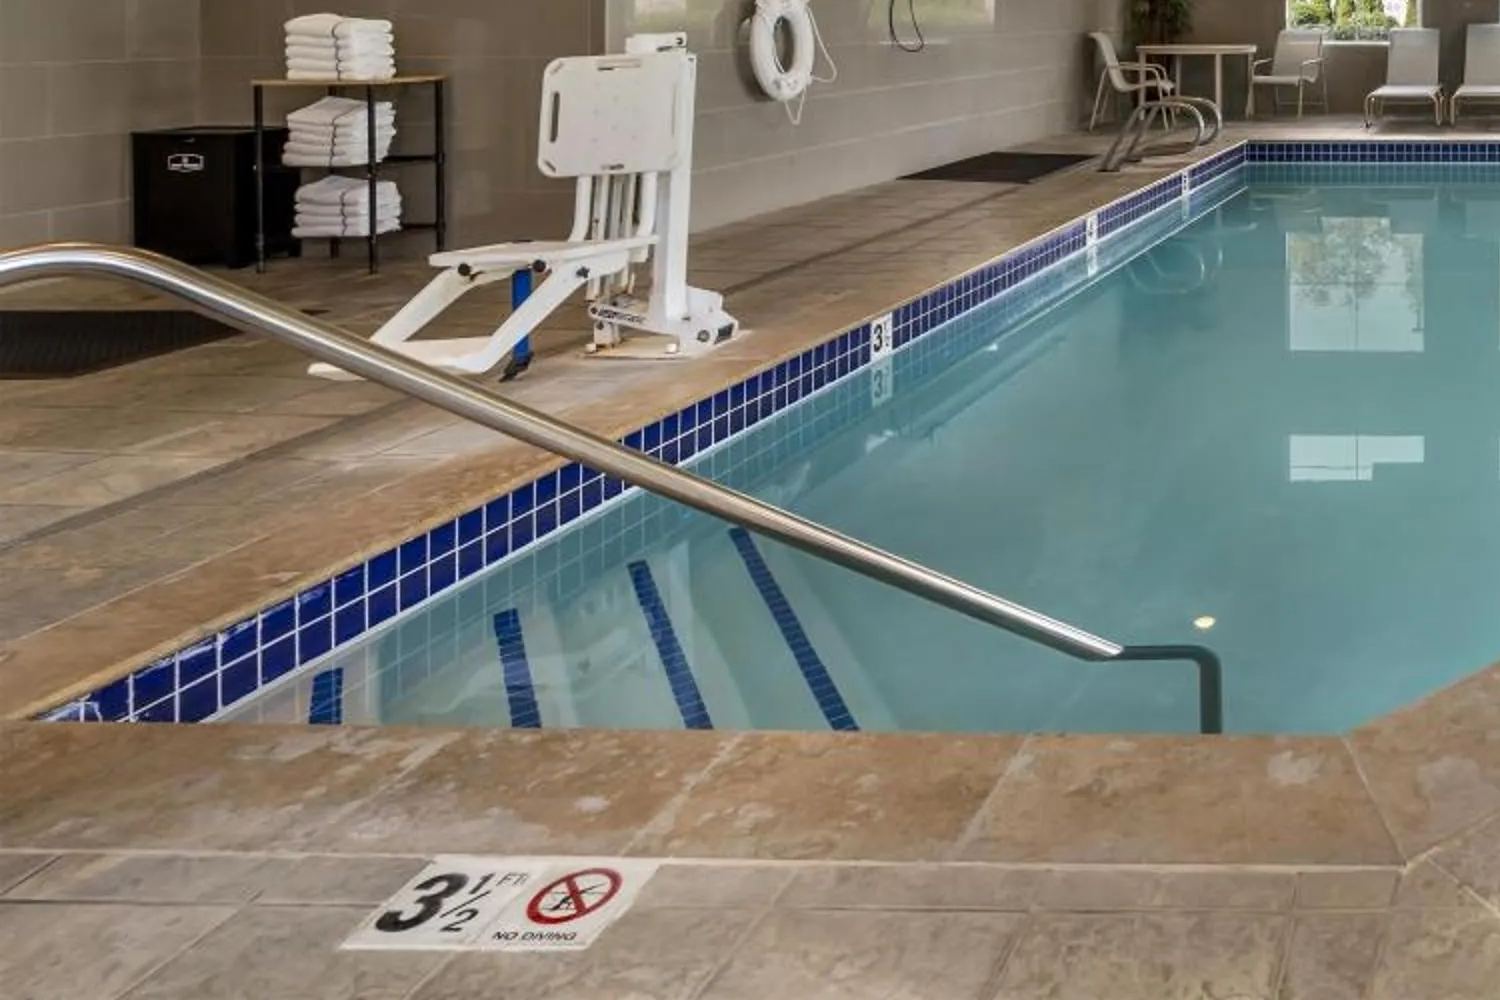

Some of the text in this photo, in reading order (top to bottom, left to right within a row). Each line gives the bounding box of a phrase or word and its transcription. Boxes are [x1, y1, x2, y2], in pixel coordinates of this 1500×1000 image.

[873, 324, 883, 352] 3
[374, 872, 470, 933] 3
[492, 931, 577, 941] NO DIVING
